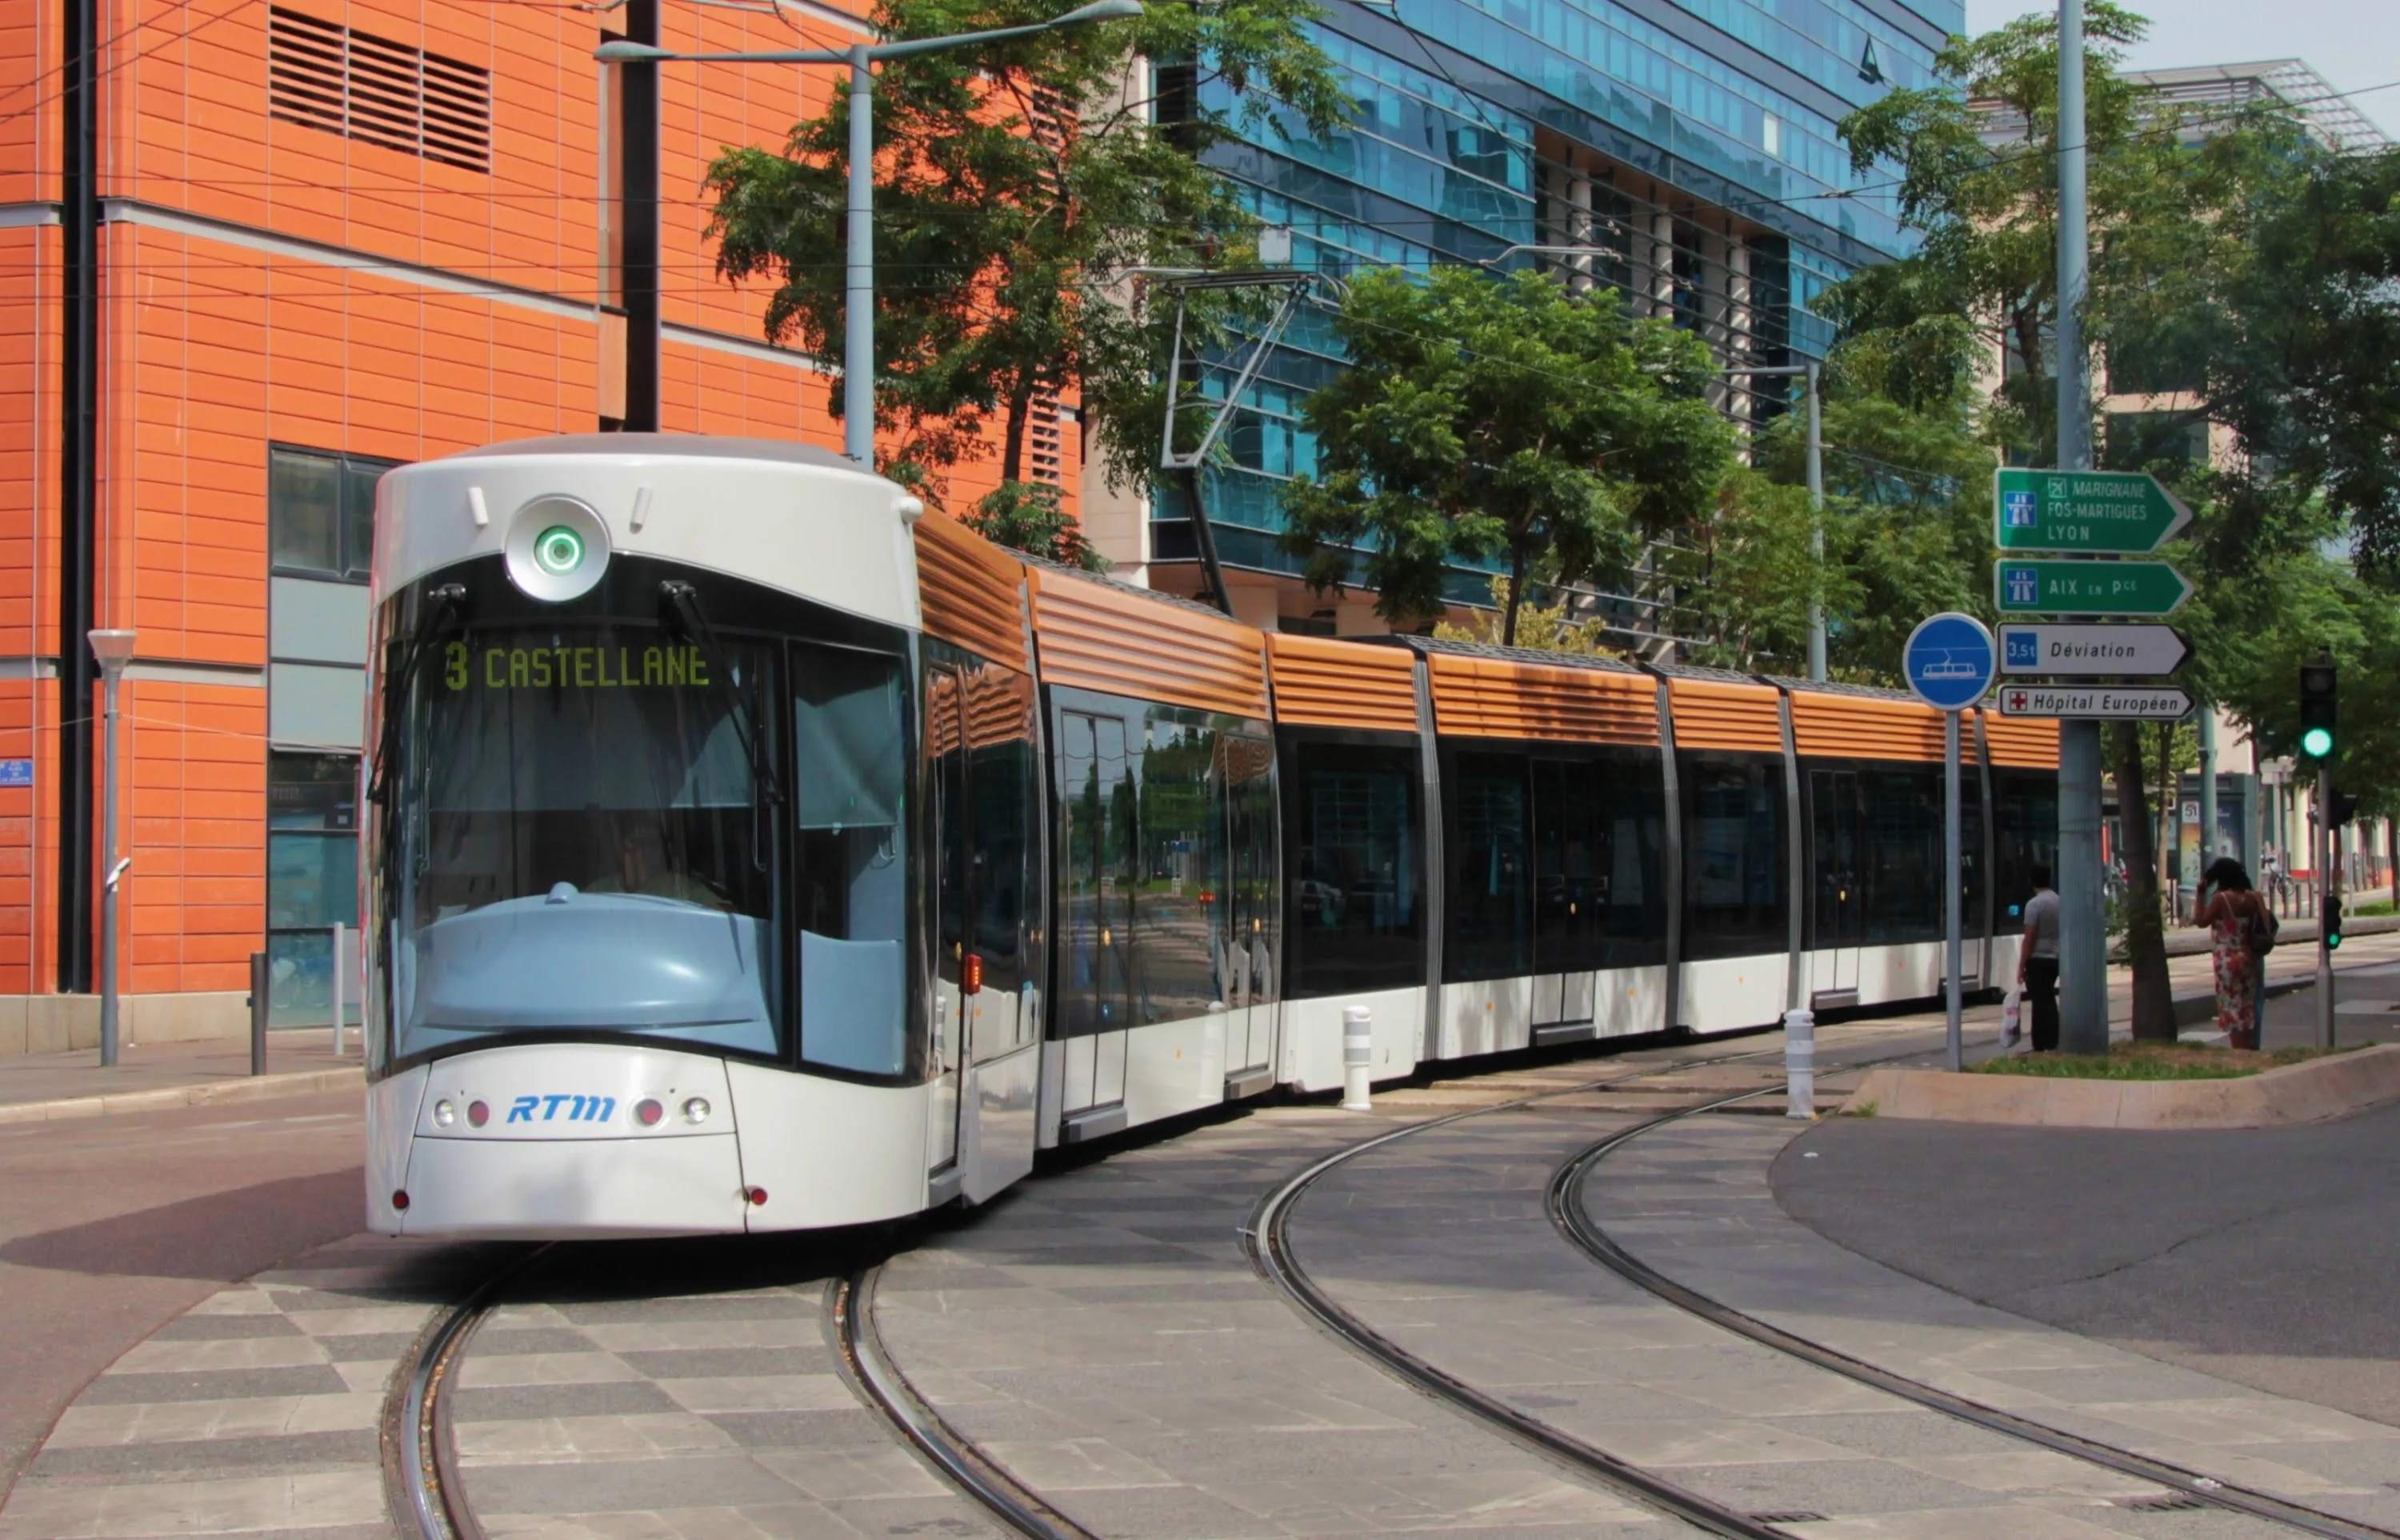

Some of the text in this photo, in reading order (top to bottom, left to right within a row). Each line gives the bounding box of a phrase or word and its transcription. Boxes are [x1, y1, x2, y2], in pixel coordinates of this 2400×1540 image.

[2072, 481, 2146, 498] MARIGNANE
[2047, 502, 2147, 520] FOS-MARTIGUES
[2048, 525, 2090, 541] LYON
[2050, 578, 2078, 596] AIX
[2087, 585, 2102, 596] EN
[2050, 642, 2135, 658] Déviation
[446, 642, 710, 690] 3 CASTELLANE
[2034, 694, 2178, 714] Hôpital Européen
[506, 1094, 616, 1124] RTM
